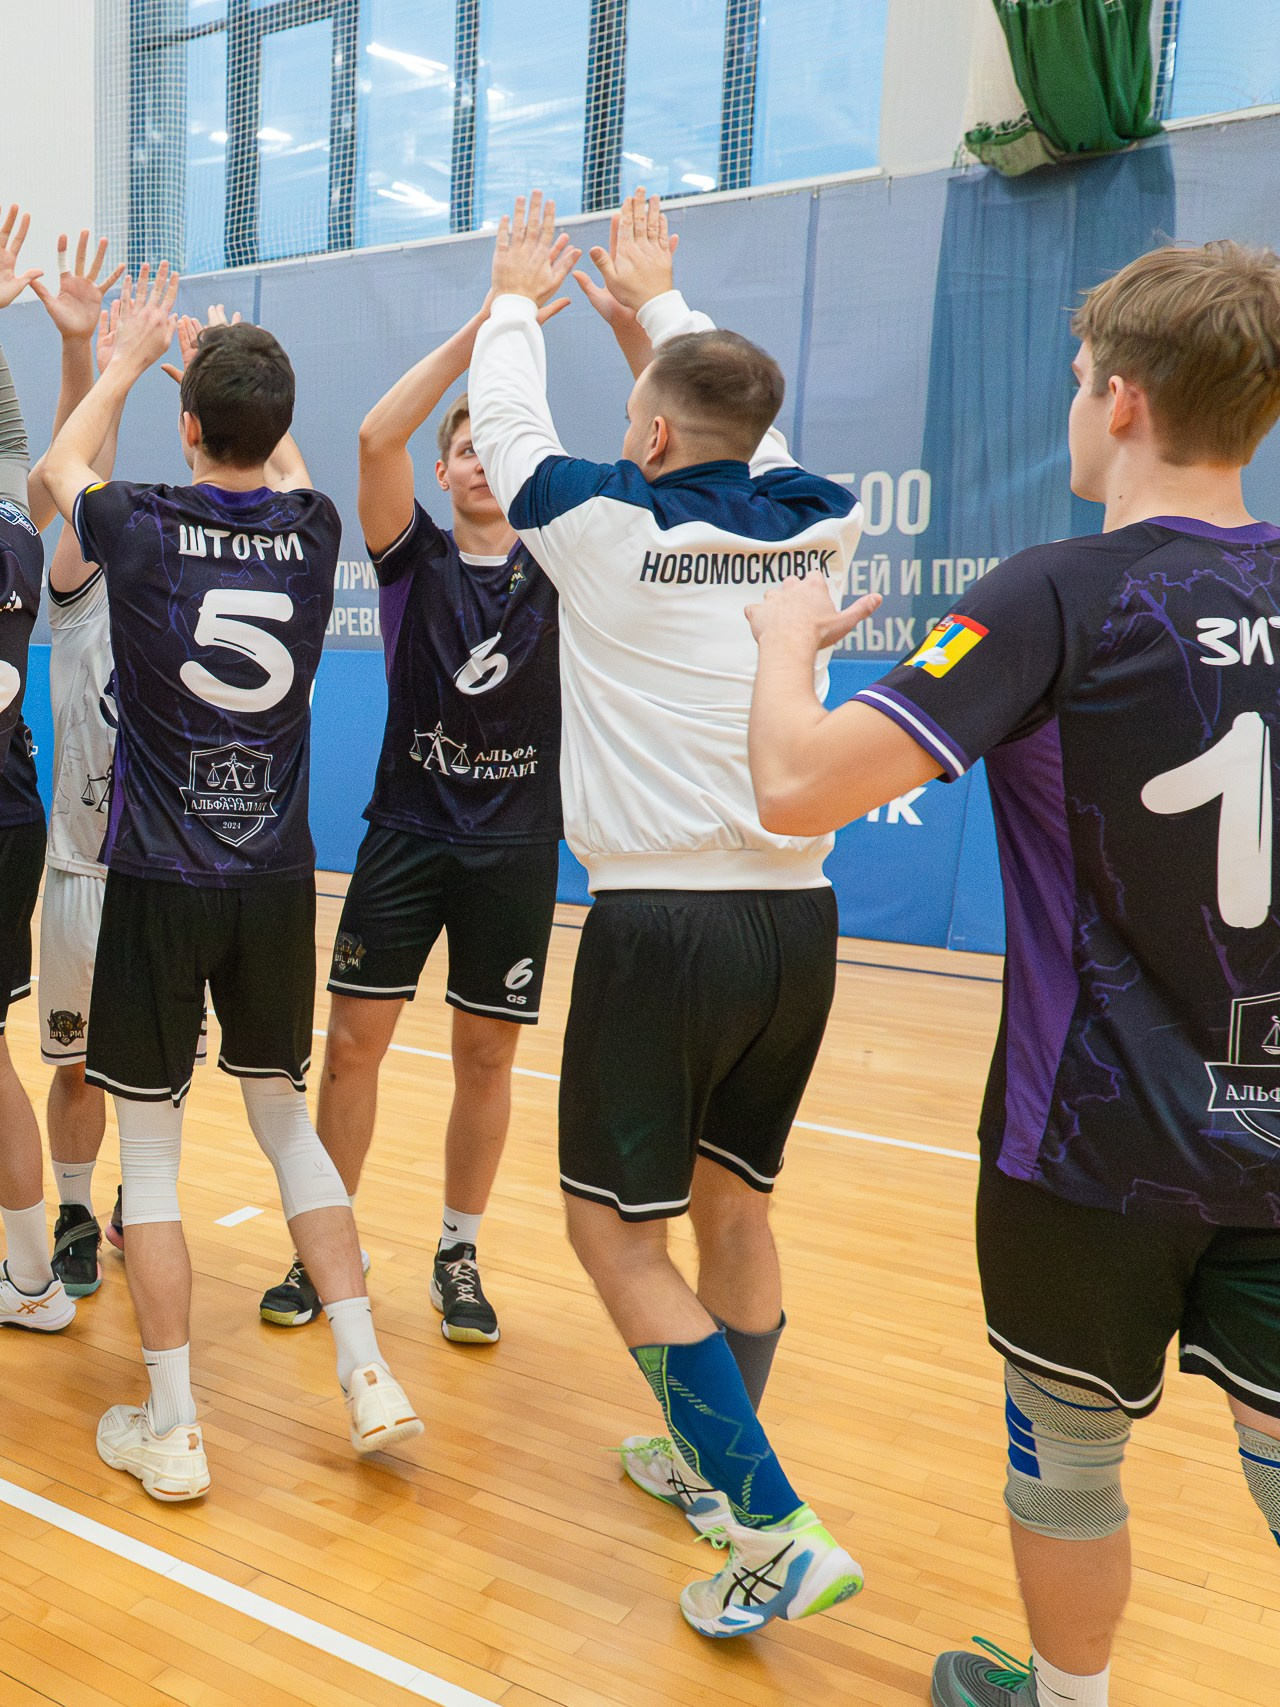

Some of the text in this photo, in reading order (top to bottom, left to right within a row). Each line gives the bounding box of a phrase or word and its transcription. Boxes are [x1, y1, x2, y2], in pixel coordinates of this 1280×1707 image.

[825, 469, 932, 536] 00
[178, 525, 304, 561] ШТОРМ
[844, 553, 891, 596] ЕЙ
[179, 589, 294, 713] 5
[453, 631, 509, 695] 6
[472, 760, 538, 780] ГАЛАНТ
[503, 957, 534, 990] 6
[506, 993, 528, 1005] GS
